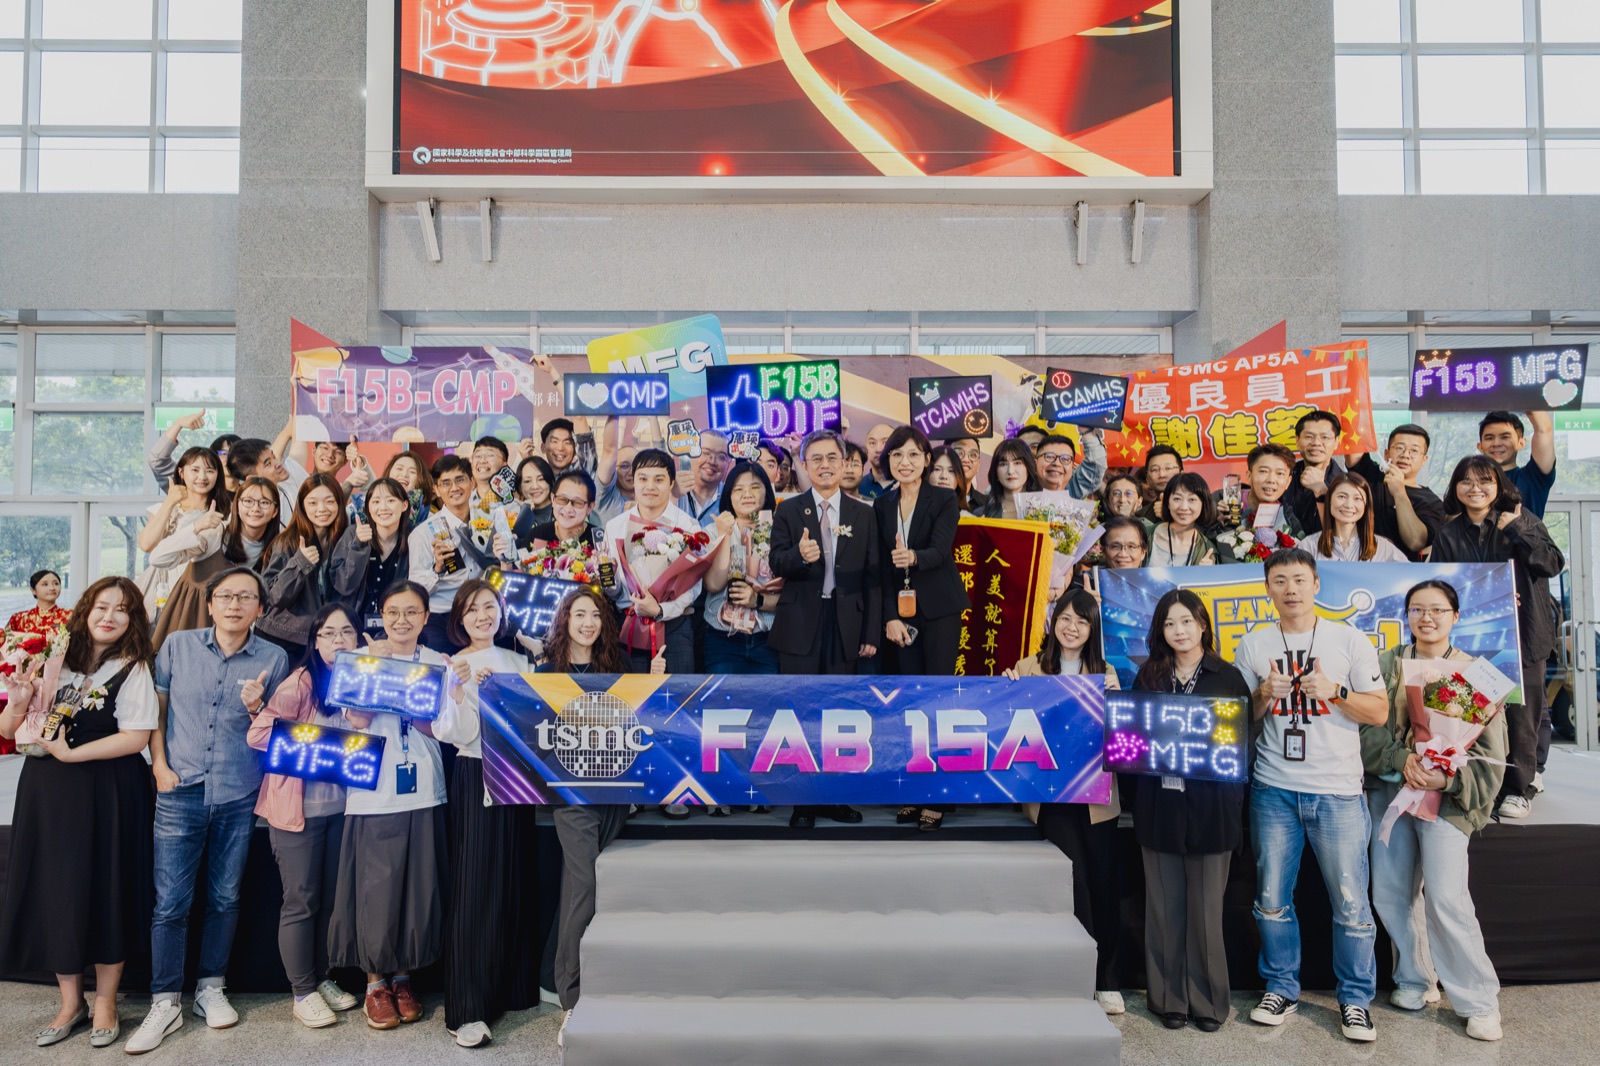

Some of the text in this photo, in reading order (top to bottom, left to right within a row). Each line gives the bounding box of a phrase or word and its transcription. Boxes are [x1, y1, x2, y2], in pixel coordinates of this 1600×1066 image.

[761, 364, 838, 400] F15B
[1164, 351, 1299, 377] TSMC AP5A
[1415, 349, 1582, 397] F15B MFG
[316, 369, 517, 415] F15B-CMP
[569, 381, 668, 410] I CMP
[914, 382, 990, 434] TCAMHS
[1047, 379, 1126, 411] TCAMHS
[1130, 365, 1351, 415] 優良員工
[762, 400, 838, 437] DIF
[505, 604, 556, 633] MF
[982, 549, 1010, 677] 人美就算了
[333, 668, 438, 713] MFG
[536, 717, 654, 752] tsmc
[1107, 700, 1212, 735] F15B
[701, 708, 1060, 773] FAB 15A
[1150, 739, 1239, 776] MFG
[272, 736, 377, 783] MFG
